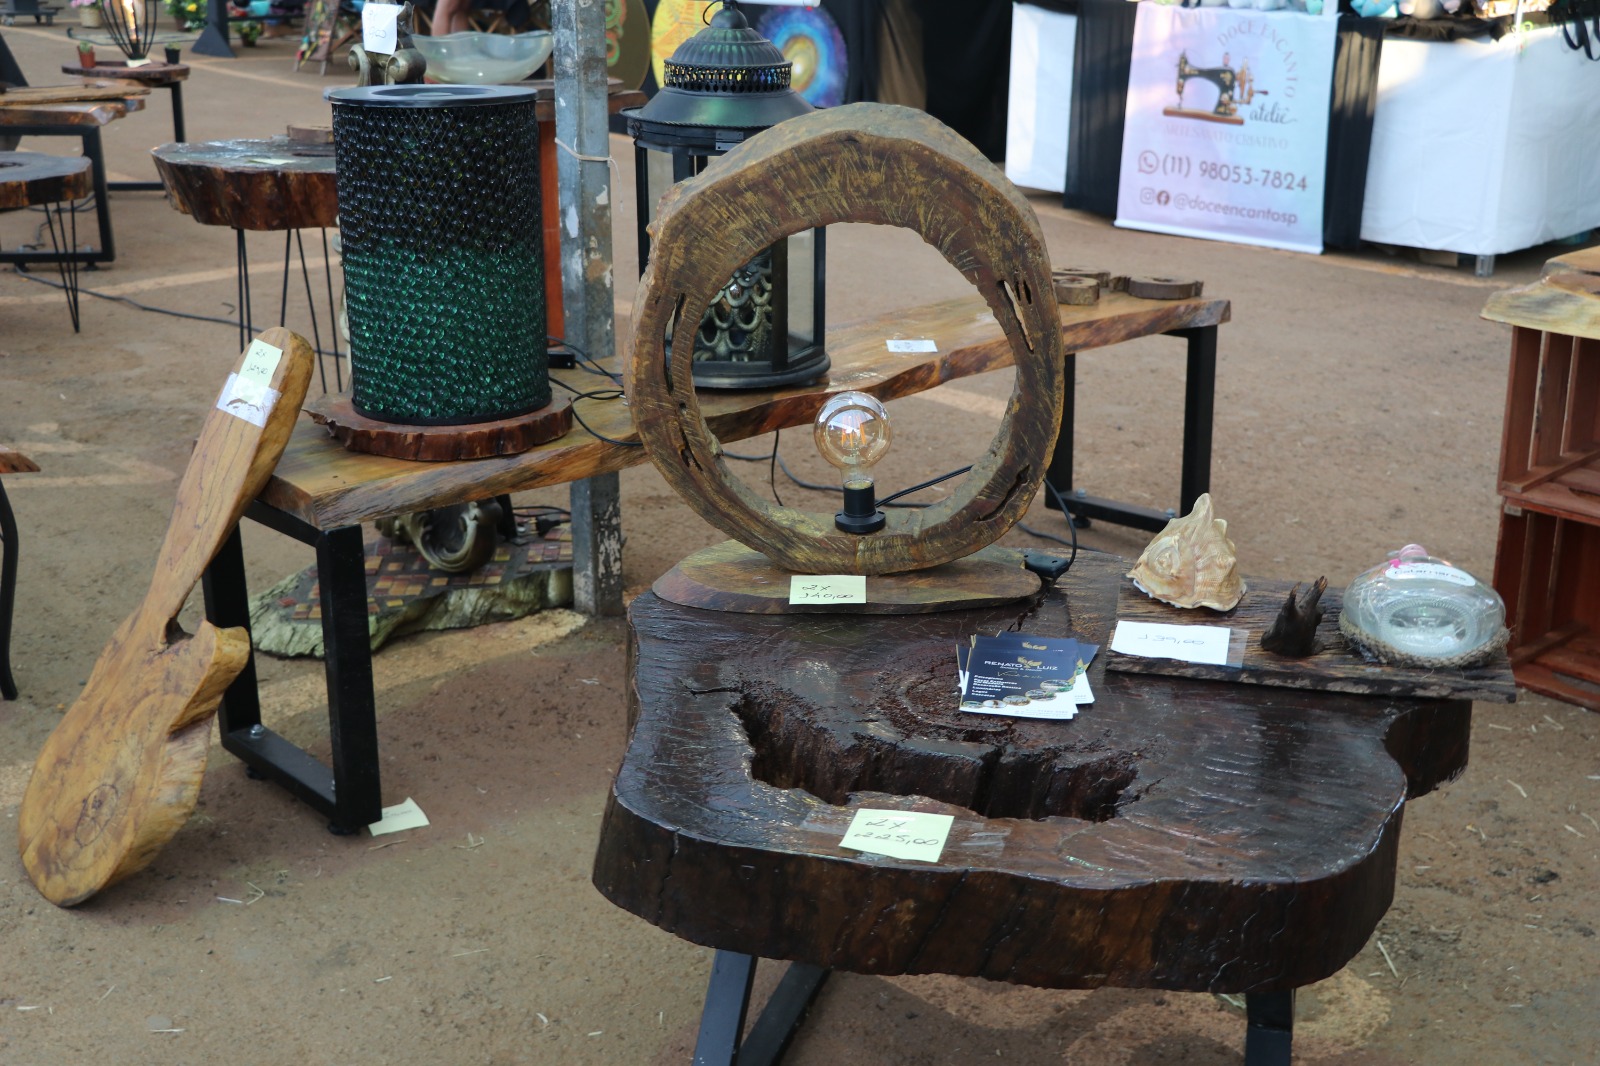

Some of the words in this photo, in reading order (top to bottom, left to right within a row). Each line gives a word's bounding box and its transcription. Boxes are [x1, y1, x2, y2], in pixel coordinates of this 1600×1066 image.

[1217, 20, 1256, 47] DOCE
[1260, 24, 1297, 98] ENCANTO
[1235, 134, 1288, 150] CRIATIVO
[1162, 154, 1191, 178] (11)
[1199, 161, 1308, 191] 98053-7824
[1174, 192, 1298, 226] @doceencantosp
[984, 660, 1022, 668] RENATO
